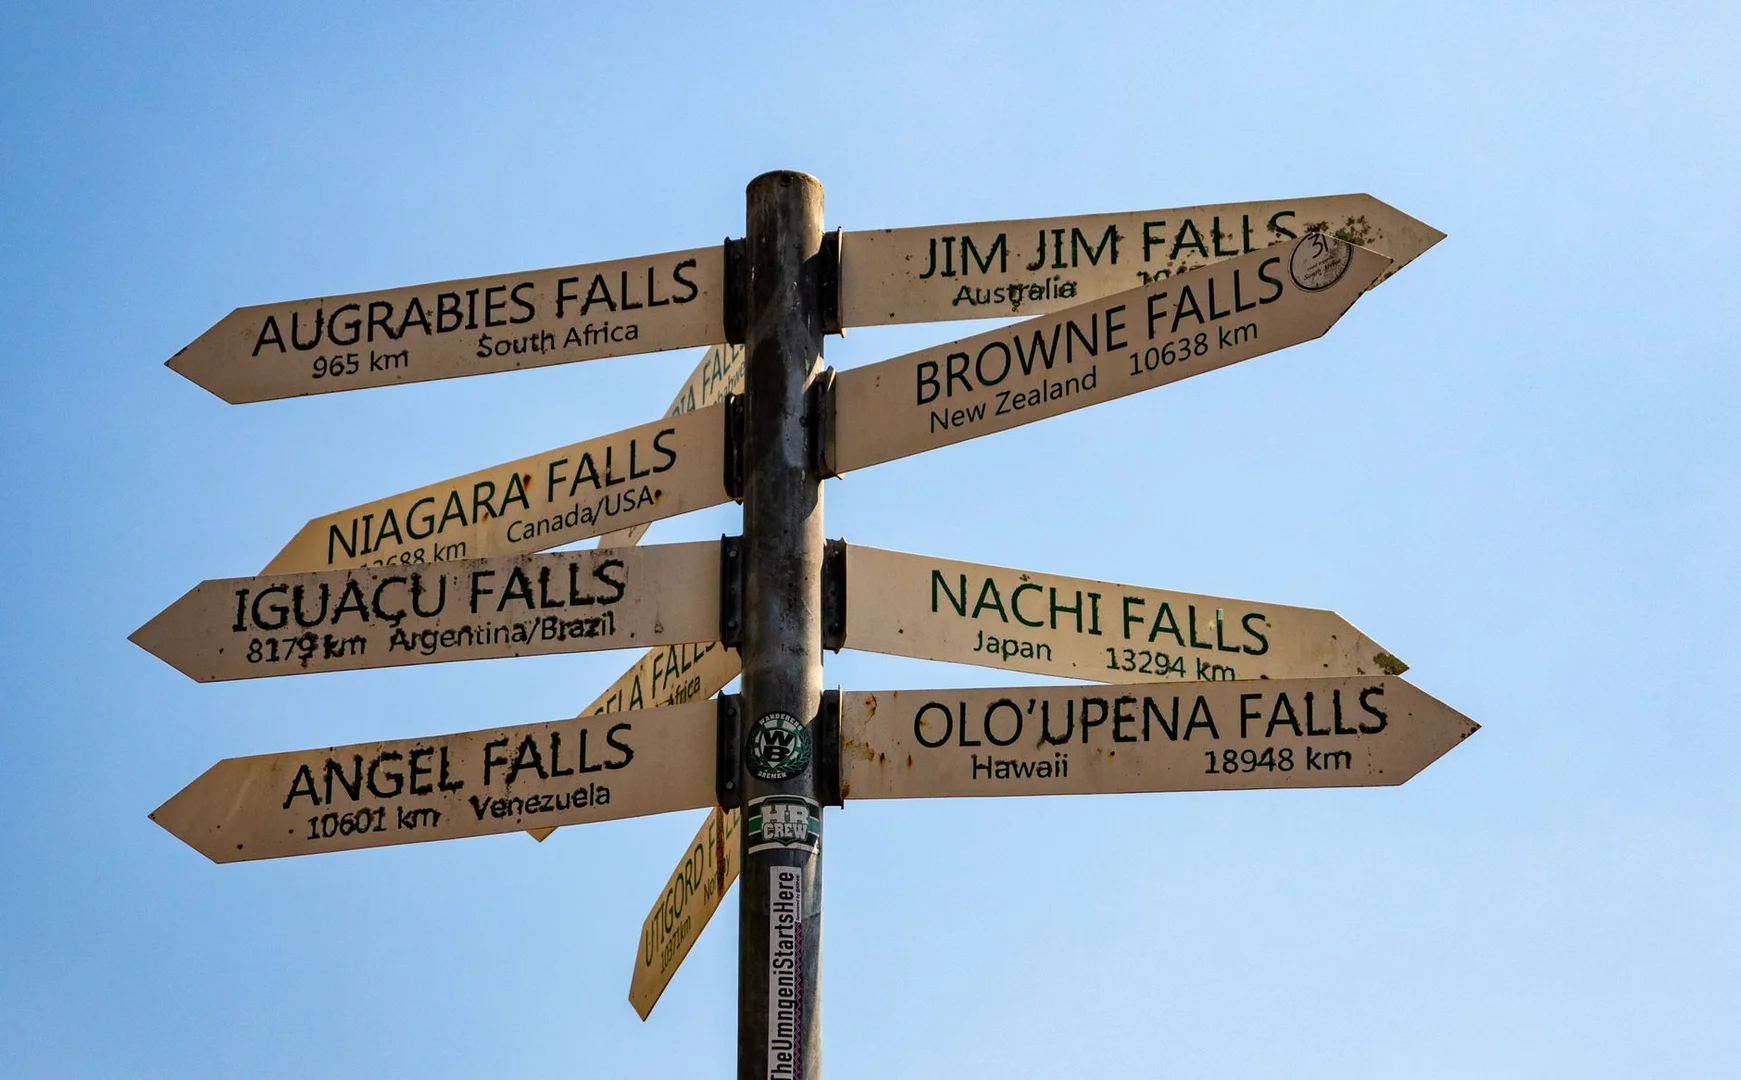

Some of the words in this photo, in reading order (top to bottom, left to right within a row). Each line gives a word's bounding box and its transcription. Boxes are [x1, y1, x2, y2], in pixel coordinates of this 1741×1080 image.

[919, 232, 1008, 279] JIM
[1027, 225, 1117, 271] JIM
[1142, 211, 1297, 262] FALLS
[252, 281, 537, 357] AUGRABIES
[555, 258, 700, 319] FALLS
[954, 275, 1077, 308] Australia
[312, 354, 360, 380] 965
[370, 347, 409, 373] km
[476, 329, 556, 360] South
[563, 320, 639, 351] Africa
[916, 305, 1127, 405] BROWNE
[1147, 256, 1284, 339] FALLS
[930, 401, 986, 434] New
[995, 366, 1097, 416] Zealand
[1129, 332, 1209, 376] 10638
[1218, 320, 1259, 349] km
[327, 472, 529, 565] NIAGARA
[547, 427, 678, 503] FALLS
[433, 541, 466, 563] km
[505, 485, 655, 544] Canada/USA
[232, 573, 448, 633] IGUAÇU
[469, 559, 626, 614] FALLS
[931, 570, 1102, 635] NACHI
[1122, 595, 1270, 656] FALLS
[246, 635, 316, 665] 8179
[324, 634, 367, 659] km
[389, 611, 615, 656] Argentina/Brazil
[973, 630, 1052, 663] Japan
[1106, 647, 1187, 678] 13294
[1197, 657, 1236, 681] km
[1239, 687, 1388, 738] FALLS
[283, 745, 464, 809] ANGEL
[483, 722, 635, 785] FALLS
[757, 769, 787, 779] BREMEN
[972, 752, 1068, 780] Hawaii
[1204, 748, 1294, 775] 18948
[1306, 746, 1352, 772] km
[306, 812, 386, 841] 10601
[397, 804, 441, 830] km
[468, 784, 611, 821] Venezuela
[763, 822, 808, 841] CREW
[645, 843, 704, 967] UTIGORD
